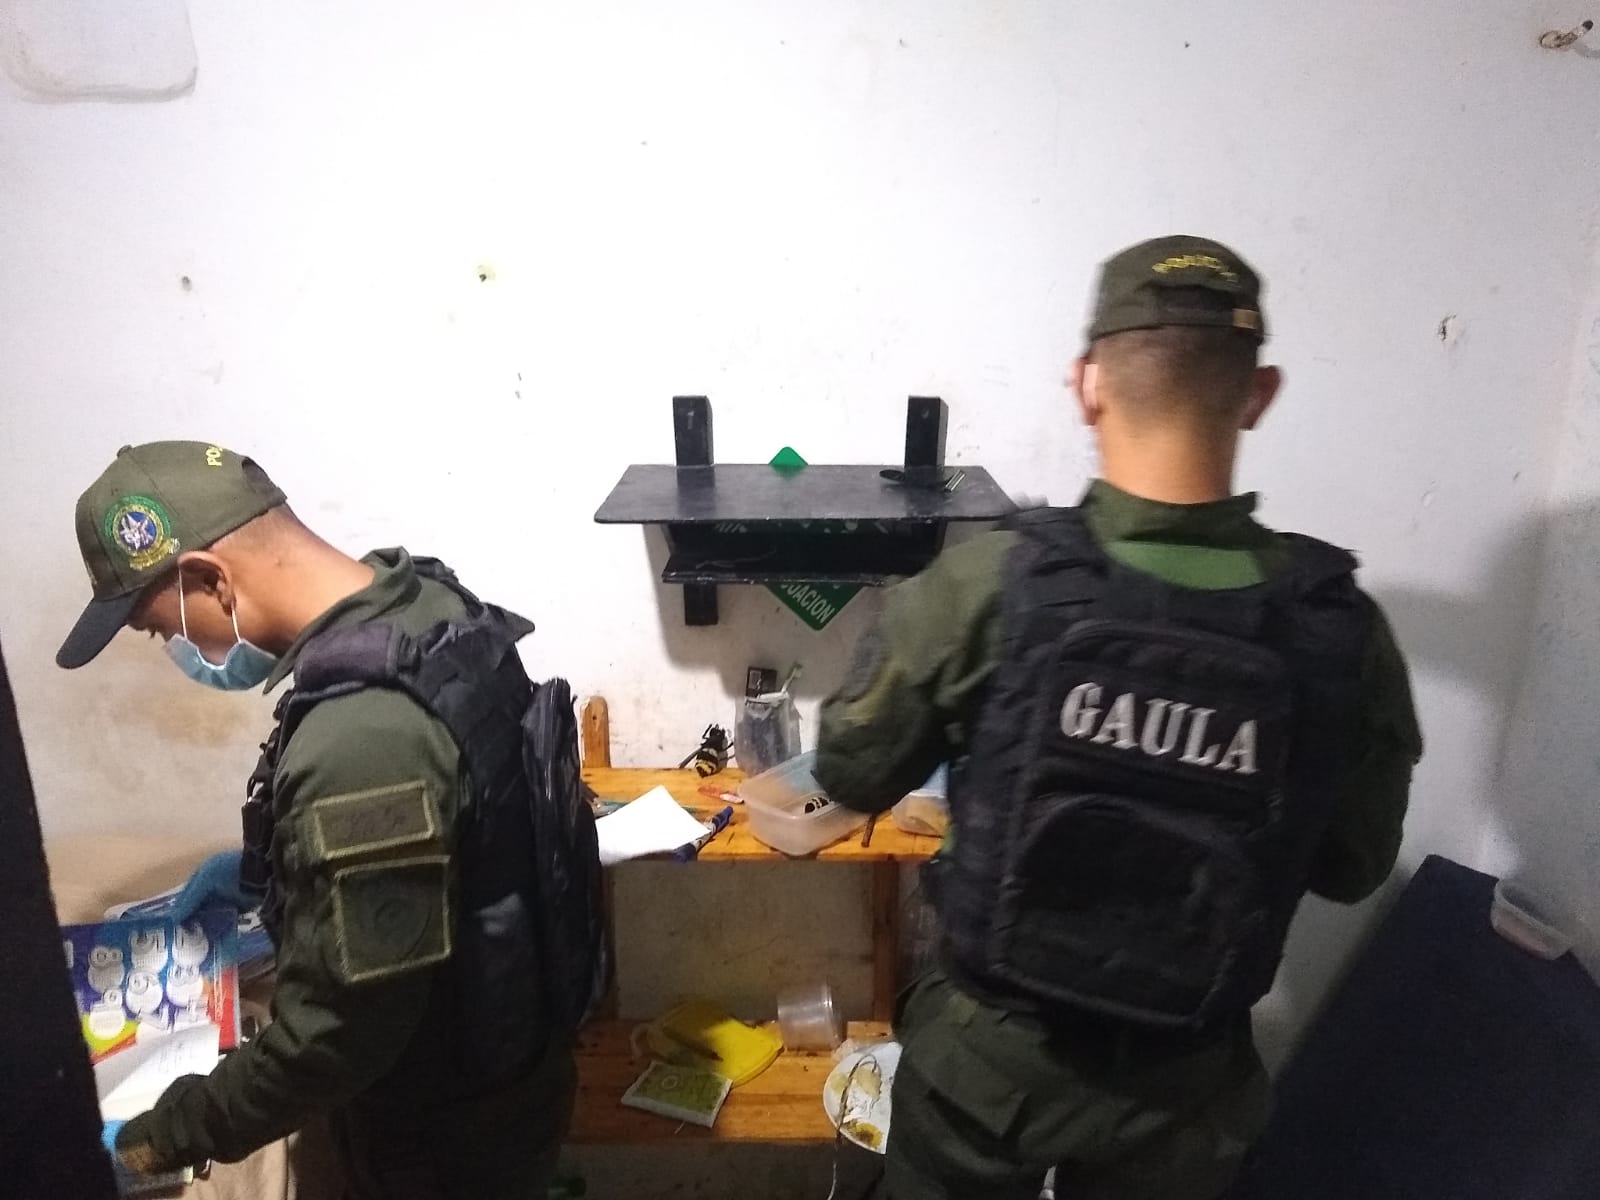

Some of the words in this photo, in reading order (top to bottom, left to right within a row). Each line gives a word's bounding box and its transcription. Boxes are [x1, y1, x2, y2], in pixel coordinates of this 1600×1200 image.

[205, 446, 223, 466] PO
[780, 583, 836, 624] UACION
[1059, 682, 1260, 774] GAULA
